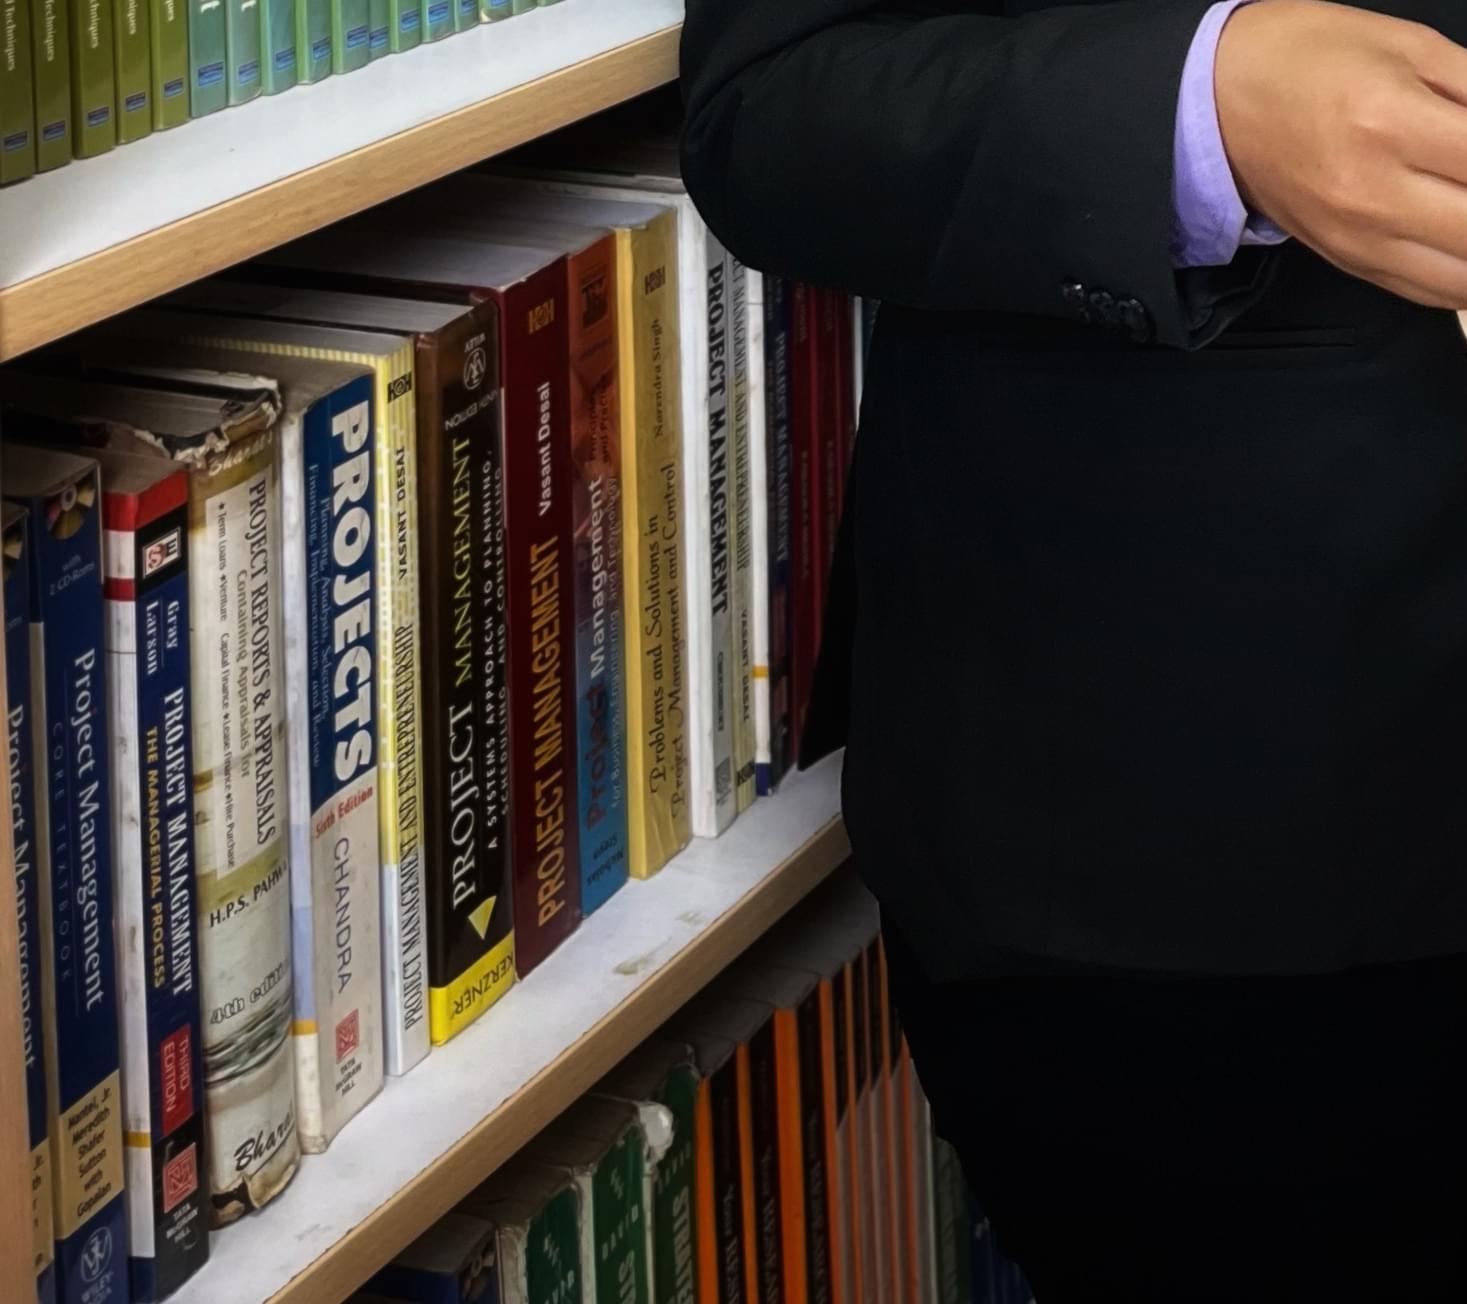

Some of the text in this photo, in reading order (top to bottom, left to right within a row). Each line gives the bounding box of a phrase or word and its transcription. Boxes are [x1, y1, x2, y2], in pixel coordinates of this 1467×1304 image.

[538, 381, 551, 516] Vasant Desai
[708, 261, 727, 615] PROJECT MANAGEMENT
[146, 600, 158, 676] Larson
[167, 600, 180, 649] Gray
[331, 400, 373, 782] PROJECTS
[483, 578, 493, 605] TO
[590, 477, 604, 679] Management
[645, 514, 666, 793] Problems and Solutions in
[662, 462, 686, 821] Project Management and Control
[236, 569, 252, 778] Containing Appraisals for
[245, 479, 276, 845] PROJECT REPORTS & APPRAISALS
[449, 436, 481, 910] PROJECT MANAGEMENT
[482, 615, 495, 725] APPROACH
[531, 535, 565, 926] PROJECT MANAGEMENT
[70, 647, 104, 1012] Project Management
[147, 727, 164, 989] THE MANAGERIAL PROCESS
[164, 687, 194, 995] PROJECT MANAGEMENT
[315, 786, 373, 840] Sixth Edition
[392, 622, 424, 1032] PROJECT MANAGEMENT AND ENTREPRENEURSHIP
[486, 737, 497, 826] SYSTEMS
[488, 836, 498, 848] A
[209, 895, 249, 928] H.P.S.
[334, 838, 353, 994] CHANDRA
[454, 950, 514, 1017] KERZNER
[162, 1041, 177, 1115] EDITION
[179, 1033, 190, 1092] THIRD
[209, 997, 245, 1025] 4th
